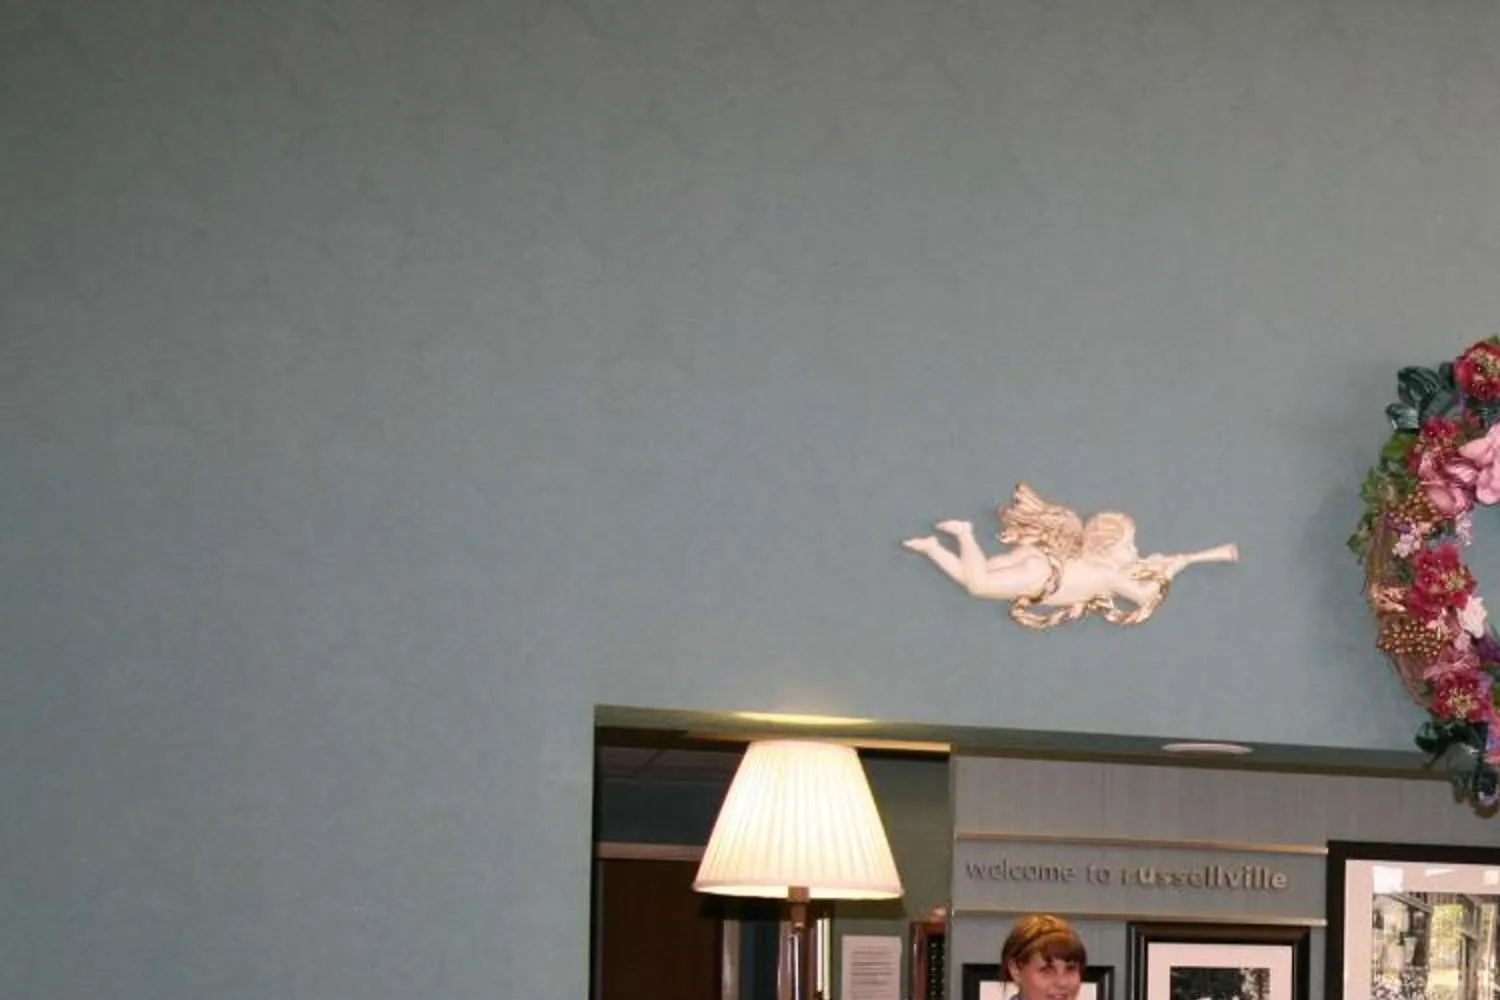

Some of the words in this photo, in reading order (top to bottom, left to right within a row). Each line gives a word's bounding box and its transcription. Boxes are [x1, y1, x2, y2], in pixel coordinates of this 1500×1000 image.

[964, 858, 1076, 880] welcome
[1087, 863, 1110, 884] to
[1121, 864, 1288, 889] russellville
